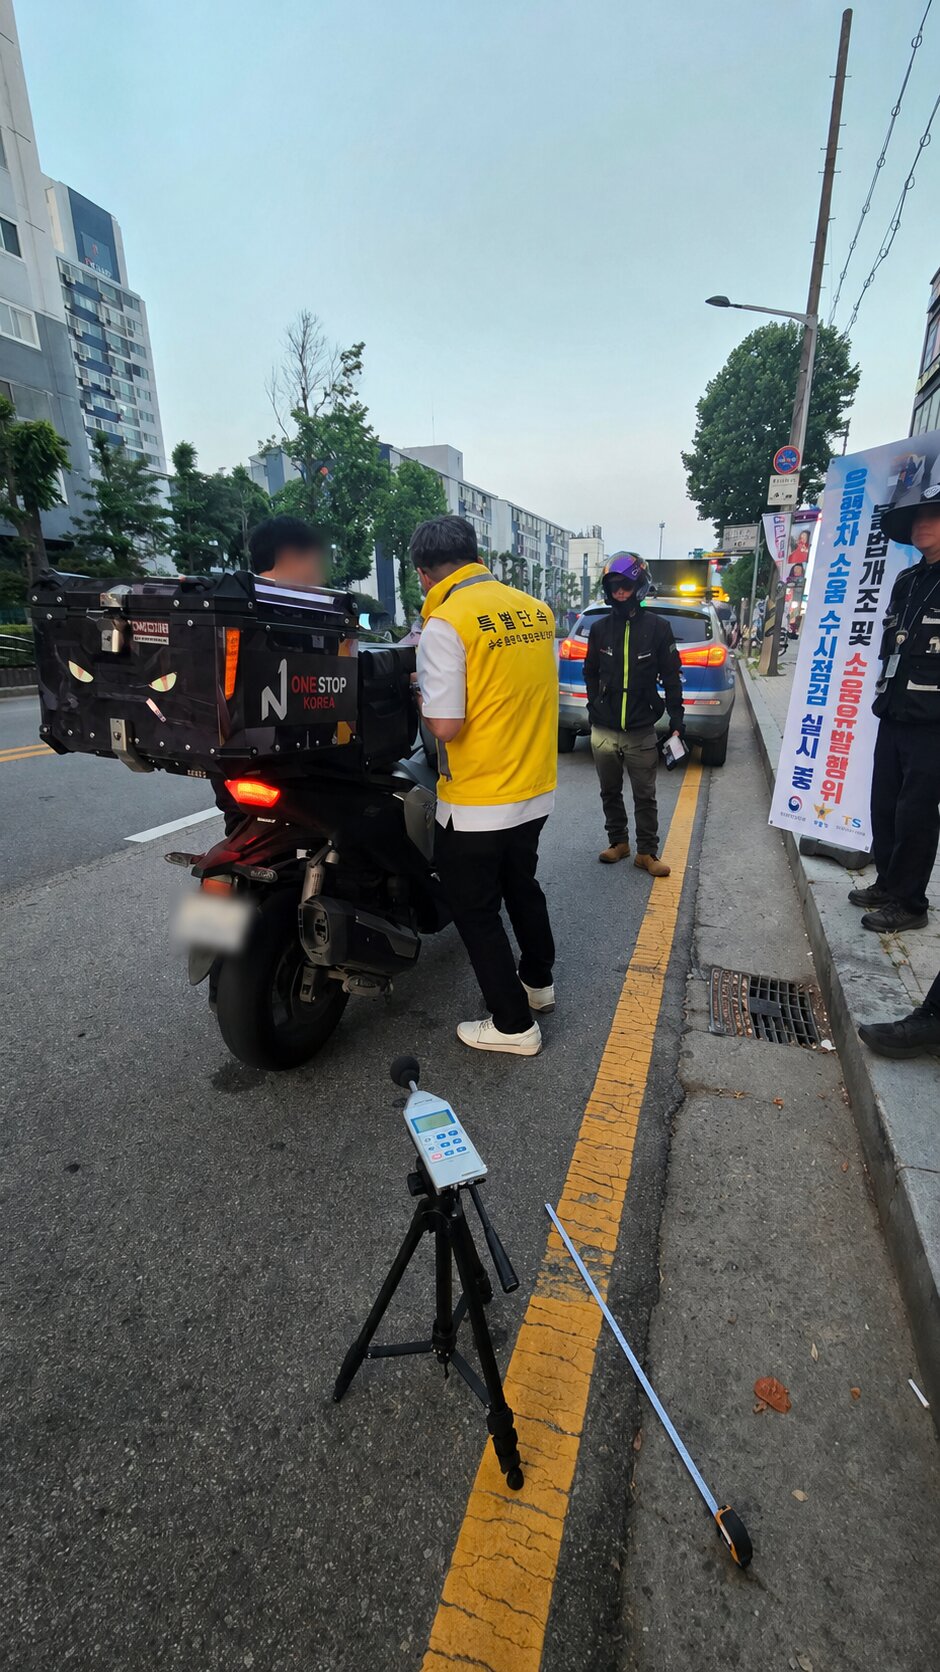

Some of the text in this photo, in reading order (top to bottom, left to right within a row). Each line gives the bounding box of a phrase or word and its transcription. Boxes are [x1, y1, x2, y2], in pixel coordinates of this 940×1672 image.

[477, 609, 548, 633] 특별단속
[849, 621, 874, 646] 및
[806, 610, 841, 706] 수시점검
[303, 696, 335, 710] KOREA
[796, 714, 823, 759] 실시
[791, 765, 814, 791] 중
[842, 815, 862, 829] TS
